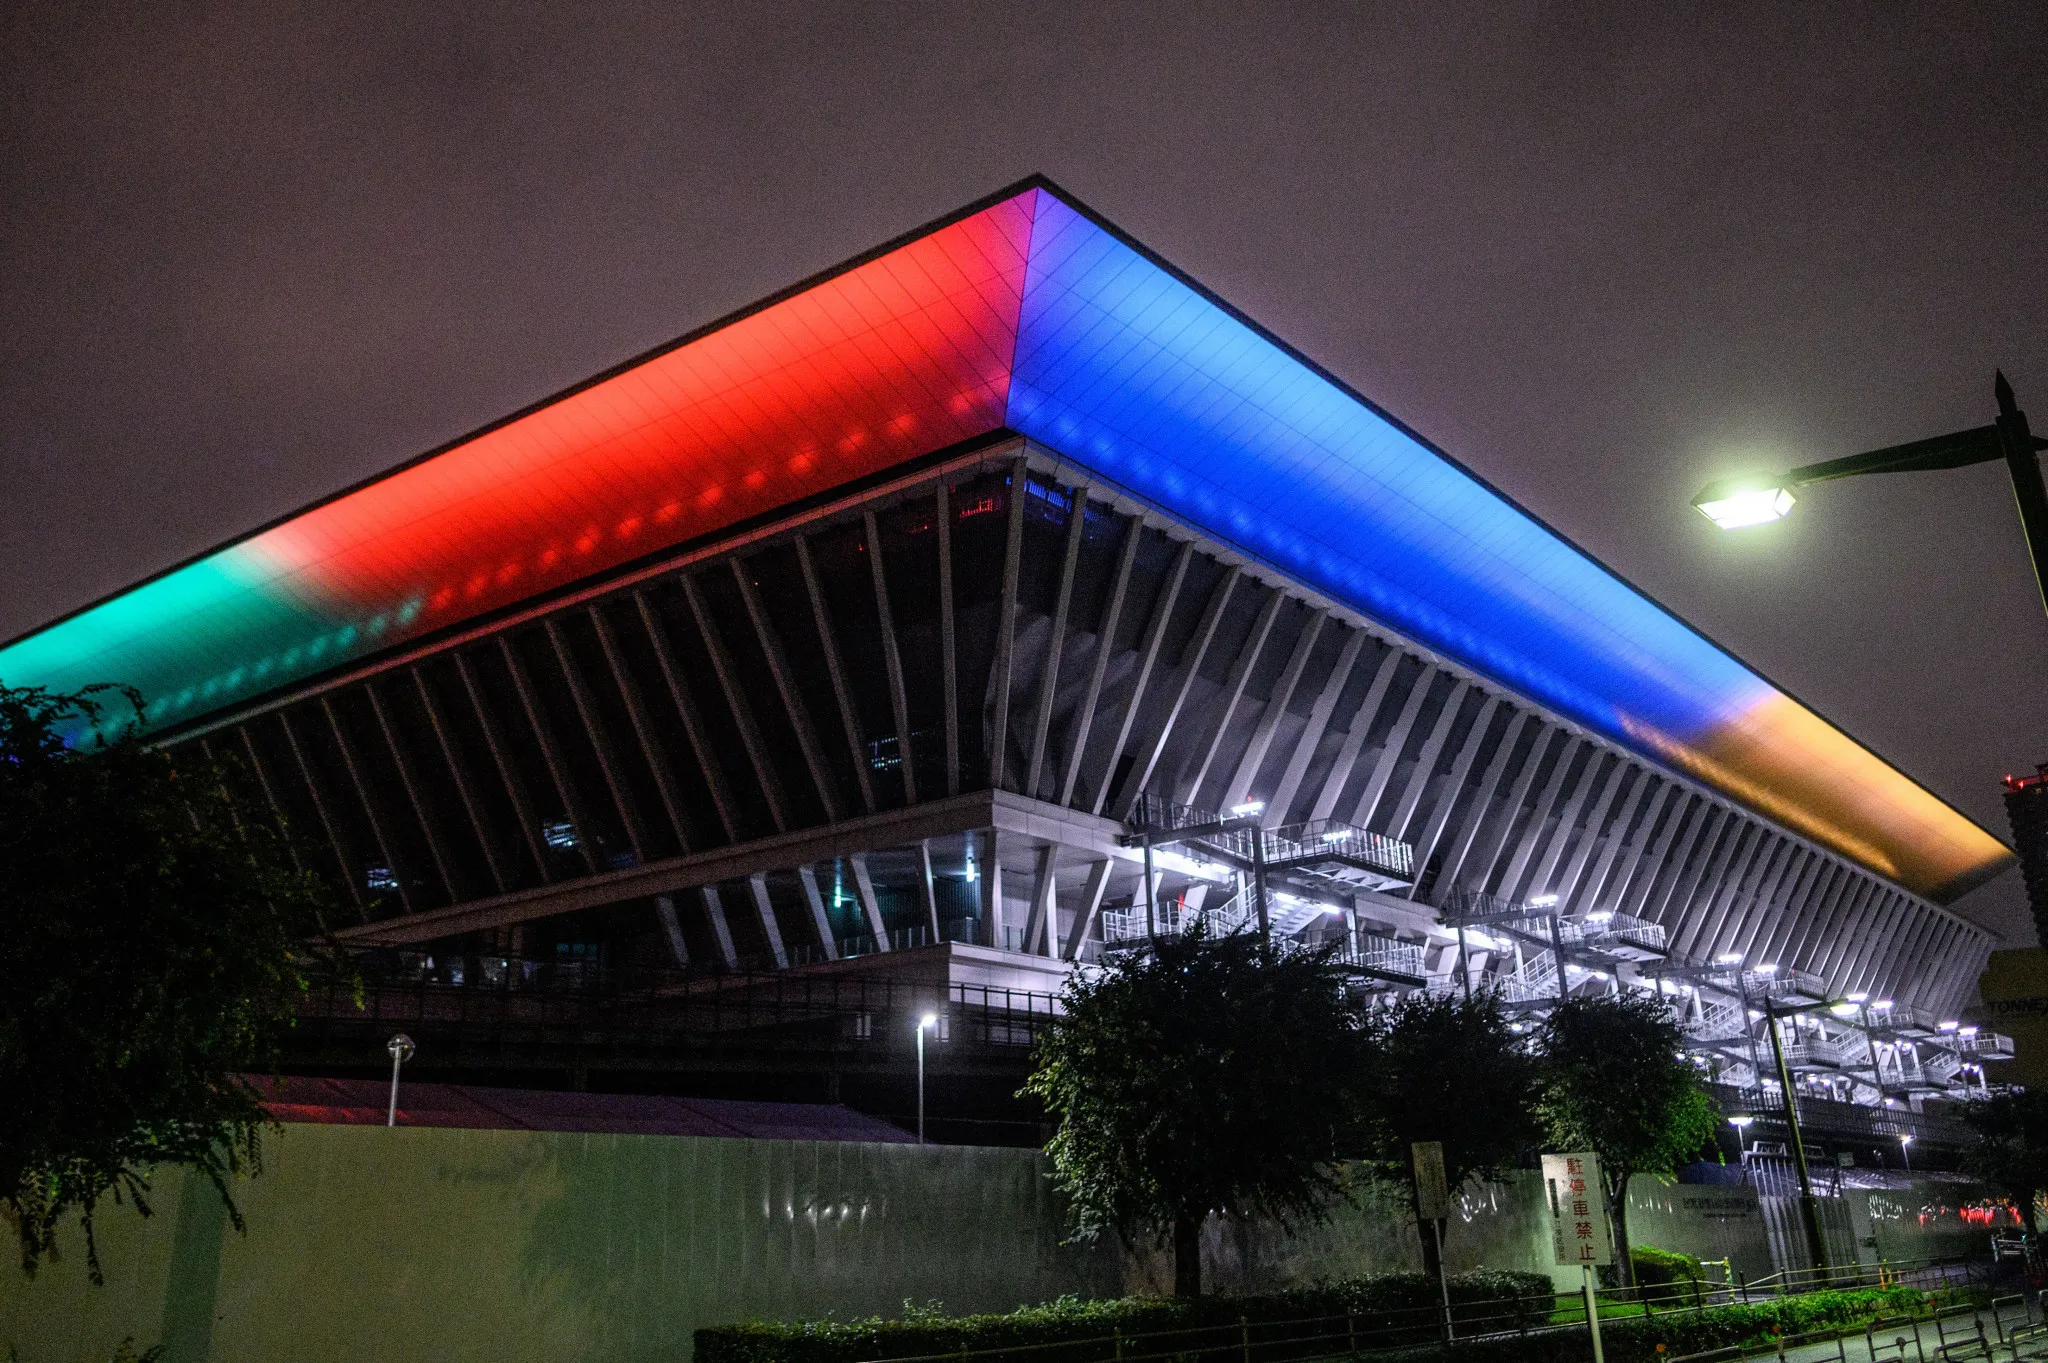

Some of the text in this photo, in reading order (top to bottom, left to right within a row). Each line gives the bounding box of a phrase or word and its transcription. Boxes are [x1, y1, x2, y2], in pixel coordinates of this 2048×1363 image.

[1566, 1158, 1596, 1261] 駐停車禁止
